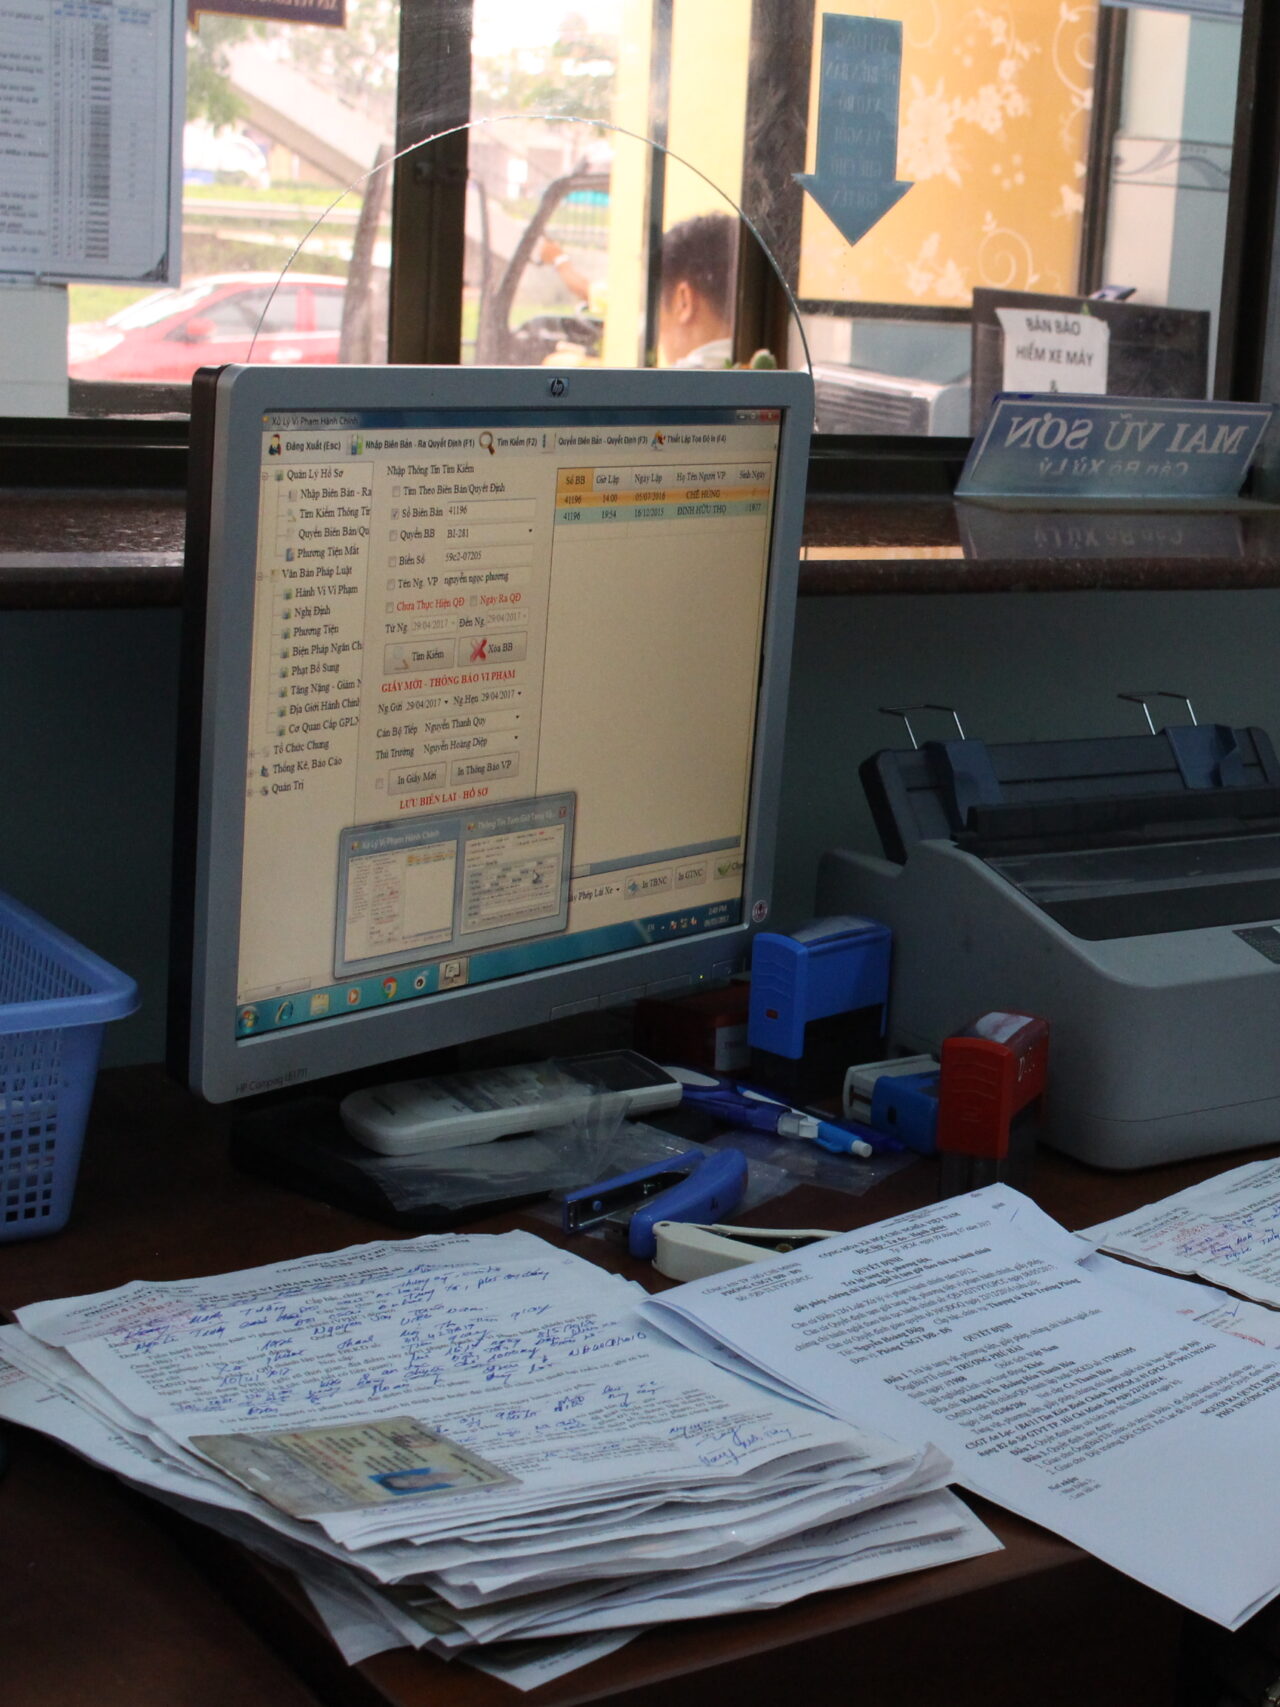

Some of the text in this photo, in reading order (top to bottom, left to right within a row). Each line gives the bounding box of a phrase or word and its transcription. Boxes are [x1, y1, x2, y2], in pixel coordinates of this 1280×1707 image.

[1050, 349, 1063, 362] XE
[1066, 348, 1094, 366] MÁY
[448, 505, 467, 515] 41196
[427, 576, 438, 586] VP
[481, 672, 489, 681] VI
[442, 792, 456, 802] LAI
